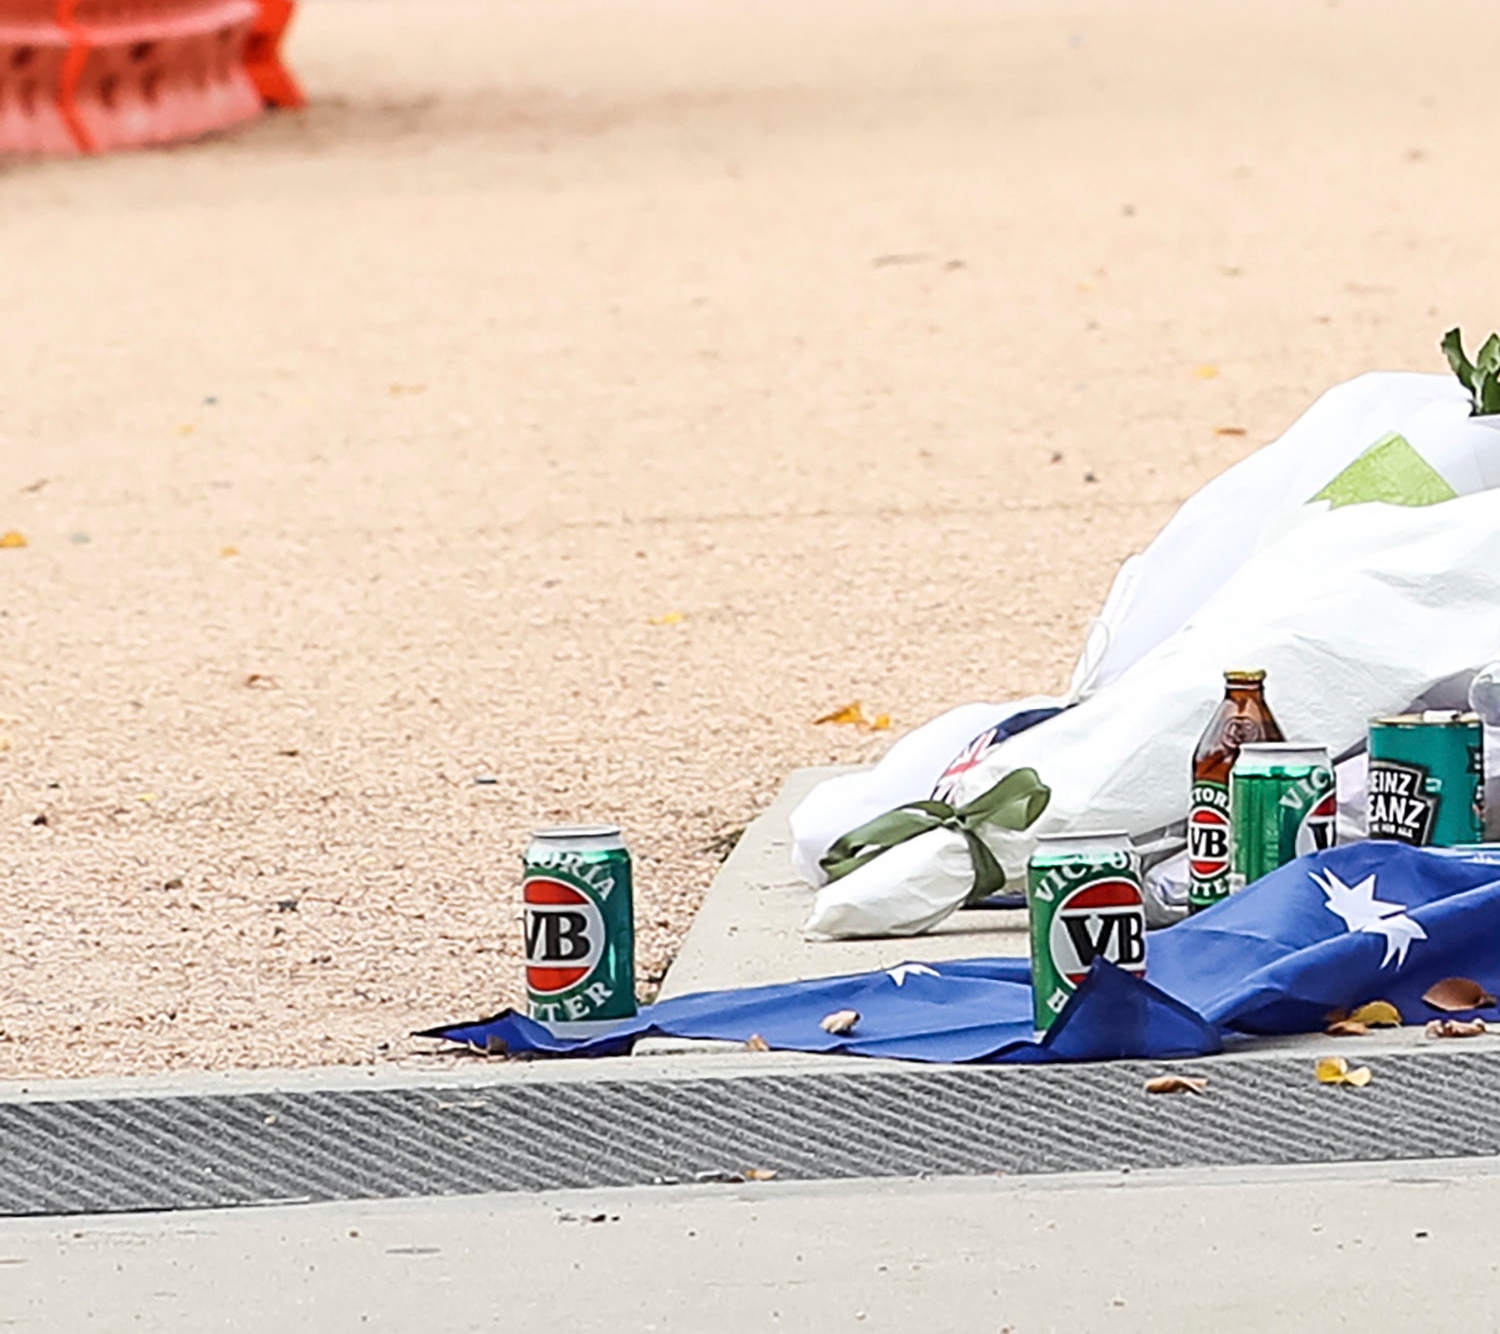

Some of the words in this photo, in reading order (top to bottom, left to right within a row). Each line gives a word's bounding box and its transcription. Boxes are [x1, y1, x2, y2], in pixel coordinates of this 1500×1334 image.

[1368, 770, 1412, 796] EINZ
[1368, 794, 1426, 829] EANZ
[523, 908, 592, 961] VB
[1059, 912, 1146, 966] VB
